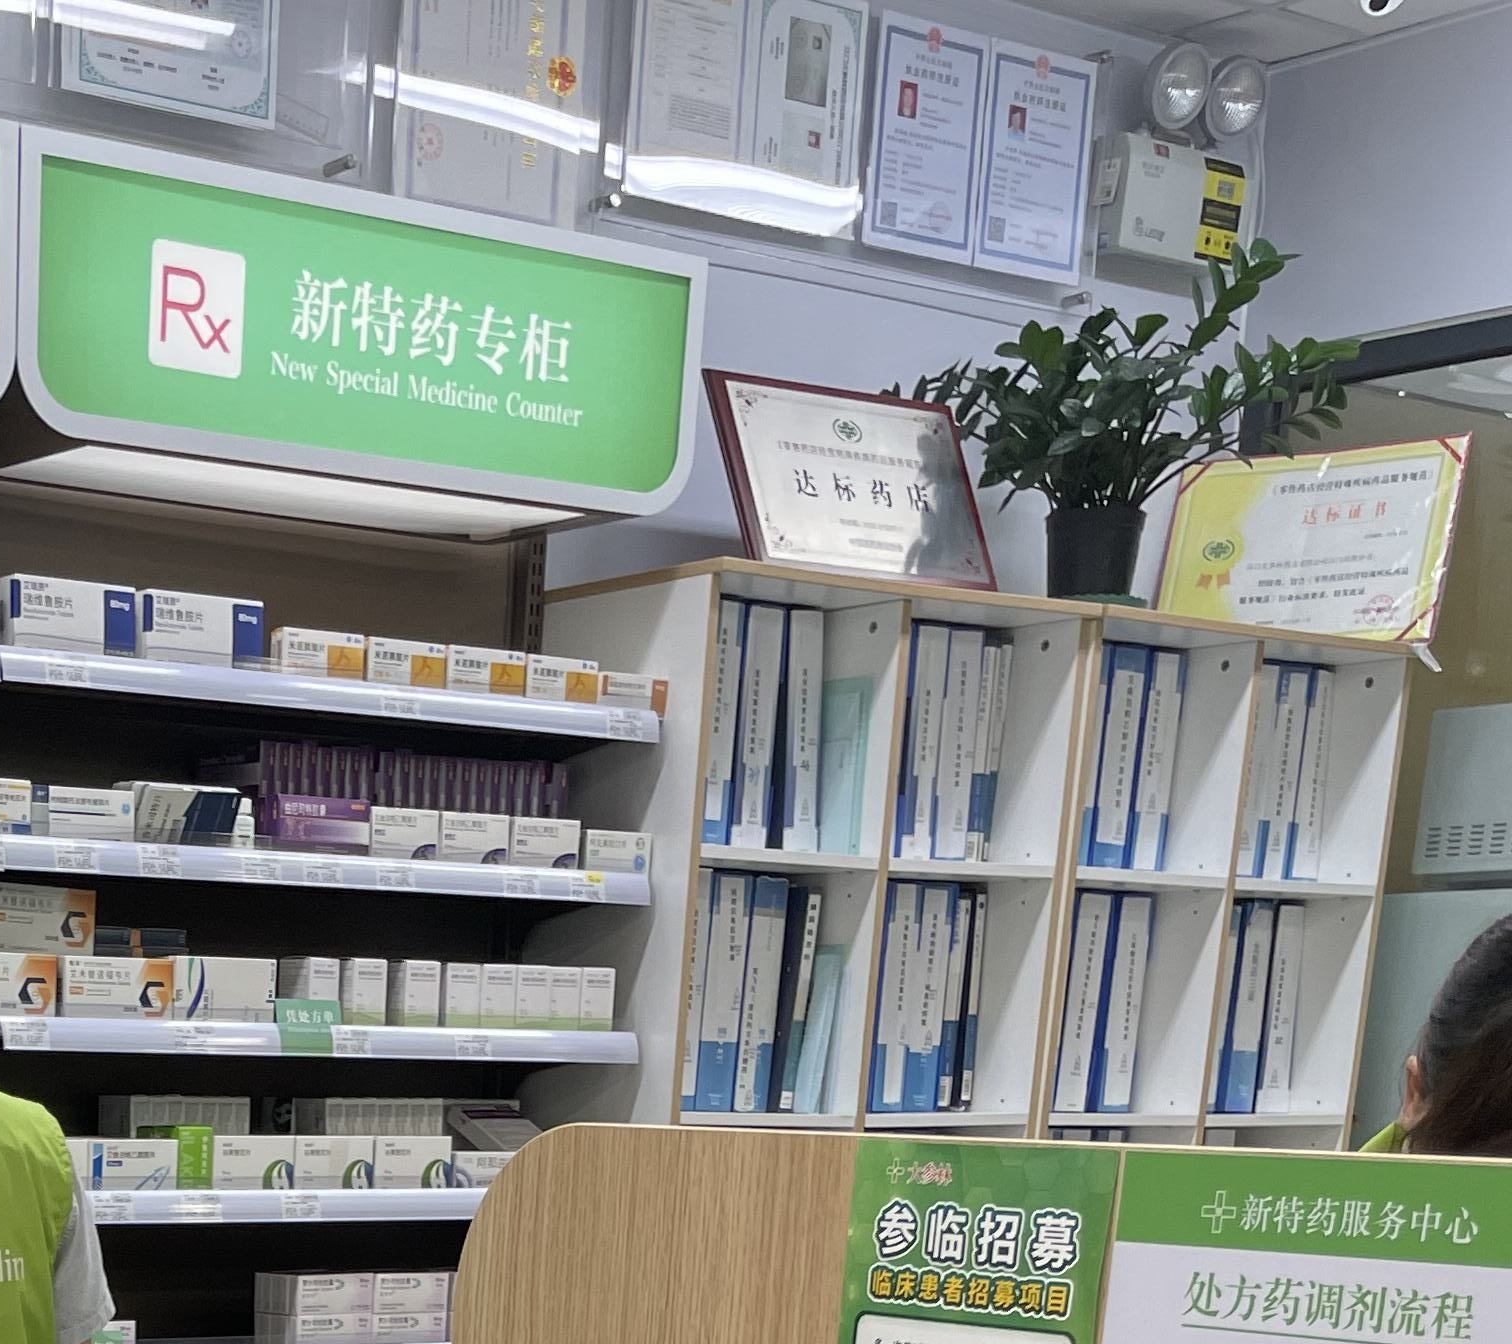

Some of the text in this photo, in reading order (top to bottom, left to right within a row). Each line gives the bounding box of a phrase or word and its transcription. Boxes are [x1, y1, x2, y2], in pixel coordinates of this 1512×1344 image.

[160, 266, 231, 354] Rx
[289, 269, 574, 385] 新特药专柜
[270, 351, 584, 429] New Special Medicine Counter
[792, 468, 930, 513] 达标药店
[1301, 501, 1388, 526] 达标证书
[876, 1202, 1078, 1272] 参临招募
[1239, 1193, 1480, 1247] 新特药服务中心
[871, 1268, 1071, 1315] 临床患者招募项目
[1181, 1270, 1476, 1342] 处方药调剂流程
